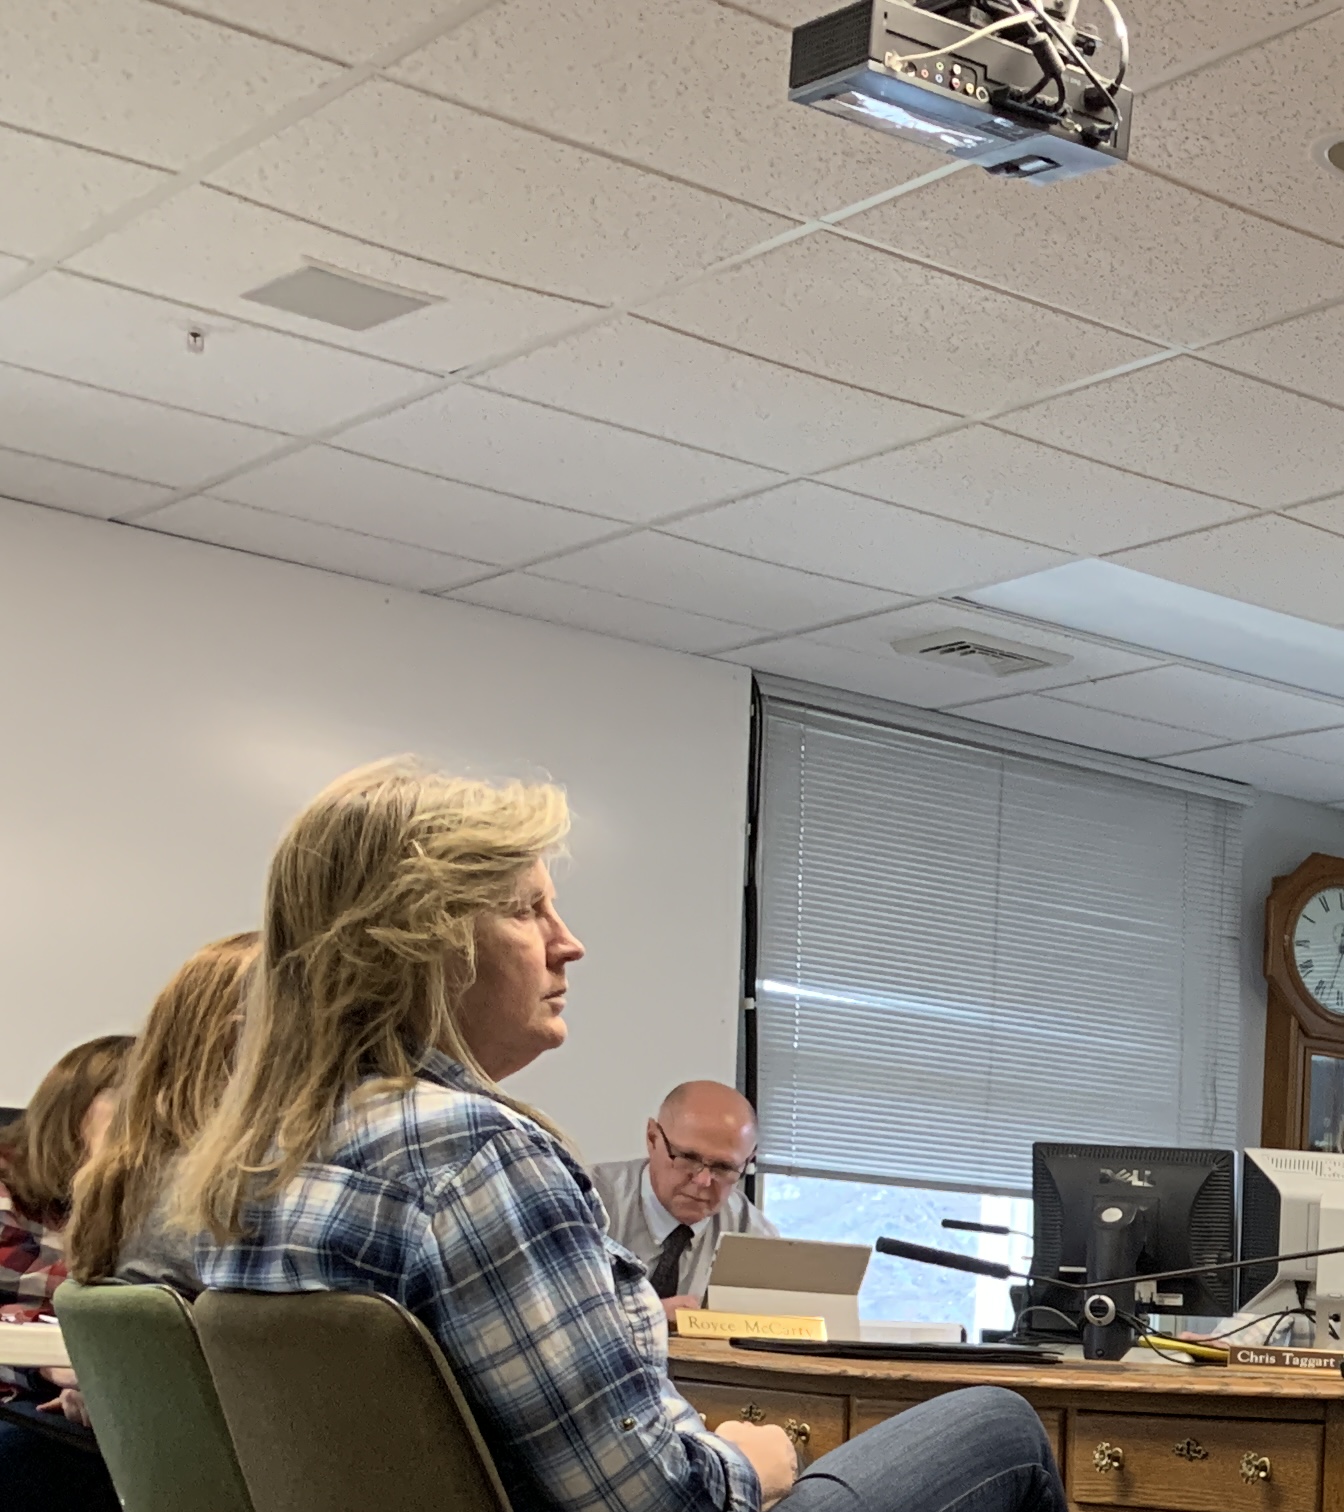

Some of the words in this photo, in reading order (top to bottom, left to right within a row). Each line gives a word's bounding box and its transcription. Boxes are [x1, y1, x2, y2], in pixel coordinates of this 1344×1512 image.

[1099, 1168, 1155, 1188] DELL
[687, 1315, 736, 1332] Royce
[744, 1319, 814, 1338] McCarty
[1236, 1349, 1277, 1364] Chris
[1282, 1352, 1336, 1369] Taggart
